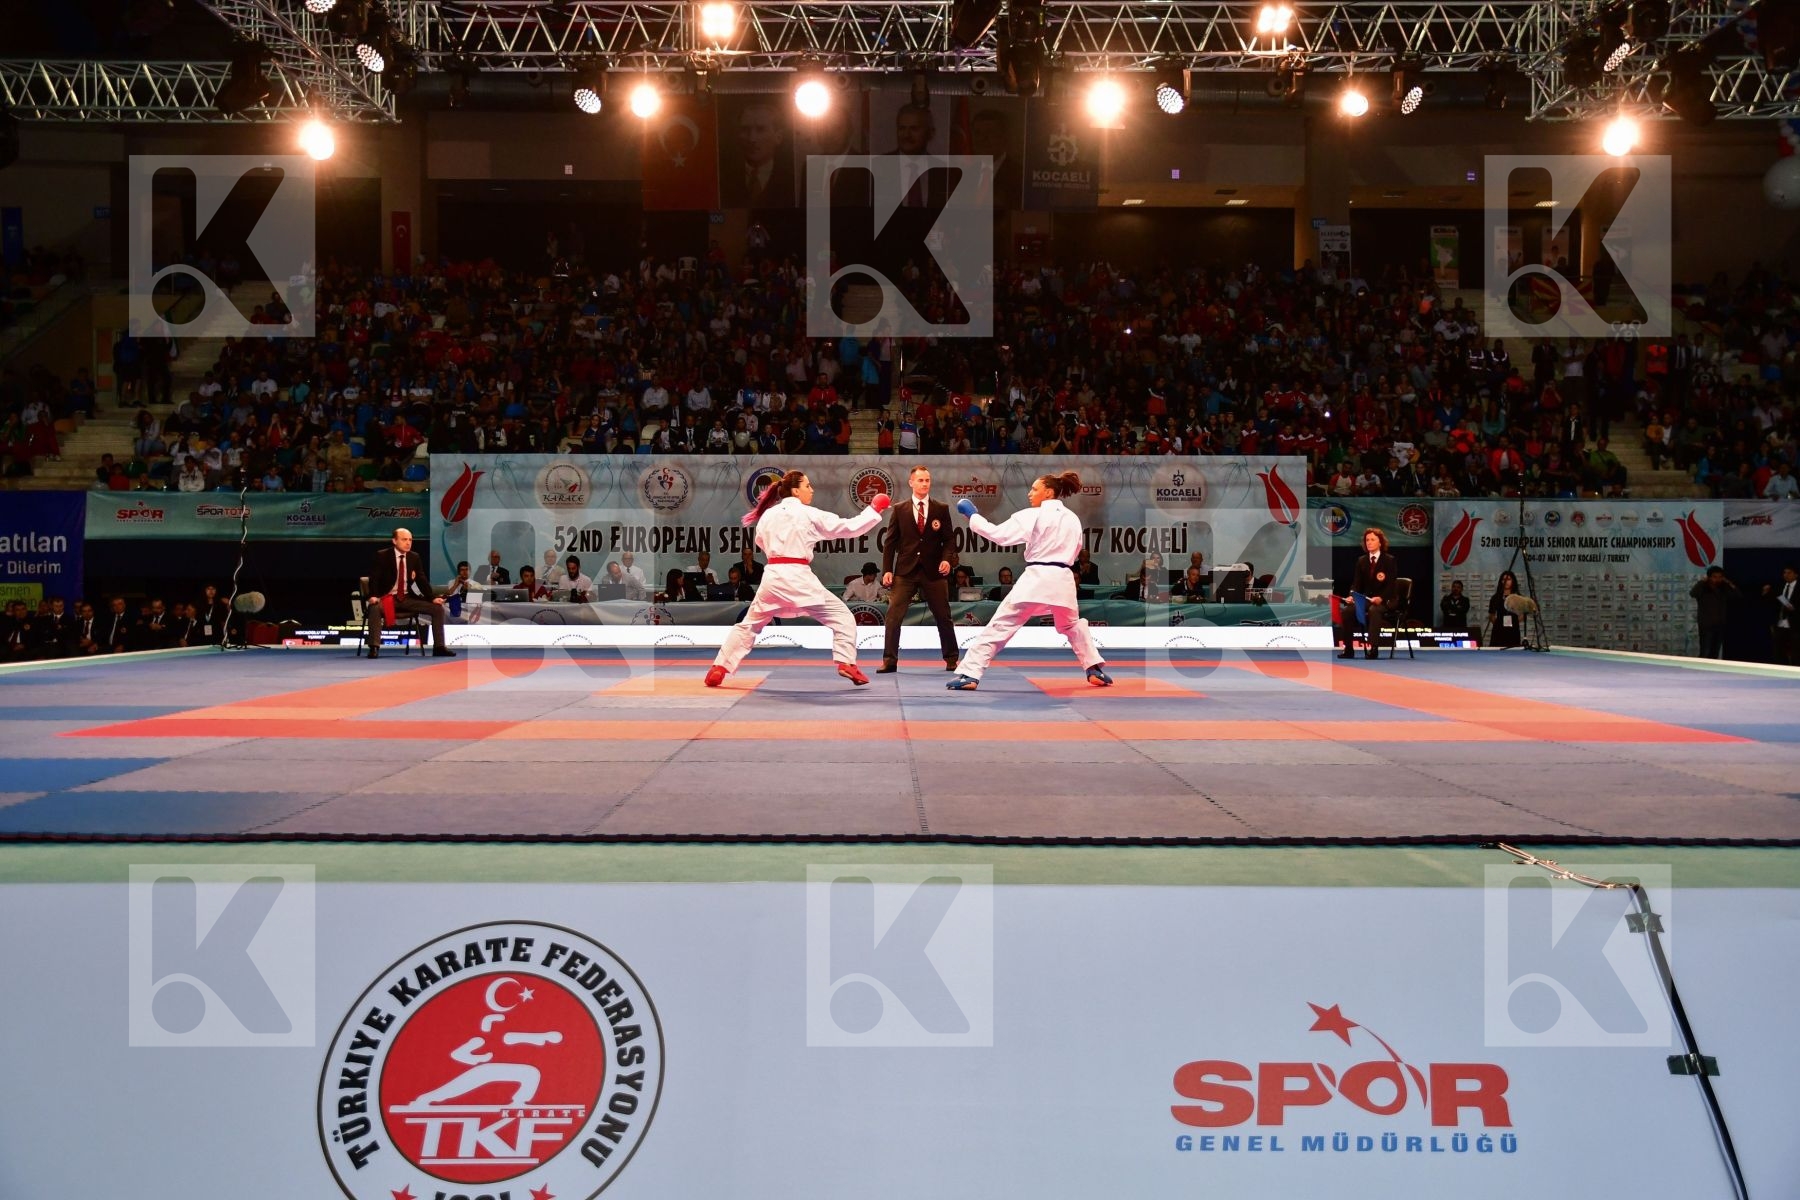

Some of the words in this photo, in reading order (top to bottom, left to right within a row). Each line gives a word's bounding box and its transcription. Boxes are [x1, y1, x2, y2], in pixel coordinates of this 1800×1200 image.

[952, 484, 997, 494] SPOR
[116, 509, 164, 519] SPOR
[554, 525, 602, 553] 52ND
[610, 526, 711, 553] EUROPEAN
[1082, 527, 1104, 553] 17
[1481, 536, 1500, 547] 52ND
[1547, 536, 1576, 548] SENIOR
[1578, 536, 1608, 548] KARATE
[1610, 536, 1676, 548] CHAMPIONSHIPS
[1562, 554, 1576, 562] 2017
[1607, 554, 1630, 562] TURKEY
[7, 560, 61, 574] Dilerim
[388, 937, 535, 1007] KARATE
[540, 942, 646, 1169] FEDERASYONU
[1170, 1059, 1513, 1128] SPOR
[501, 1110, 586, 1118] KARATE
[405, 1117, 573, 1158] TKF
[1175, 1135, 1285, 1152] GENEL
[1301, 1132, 1518, 1154] MÜDÜRLÜĞÜ
